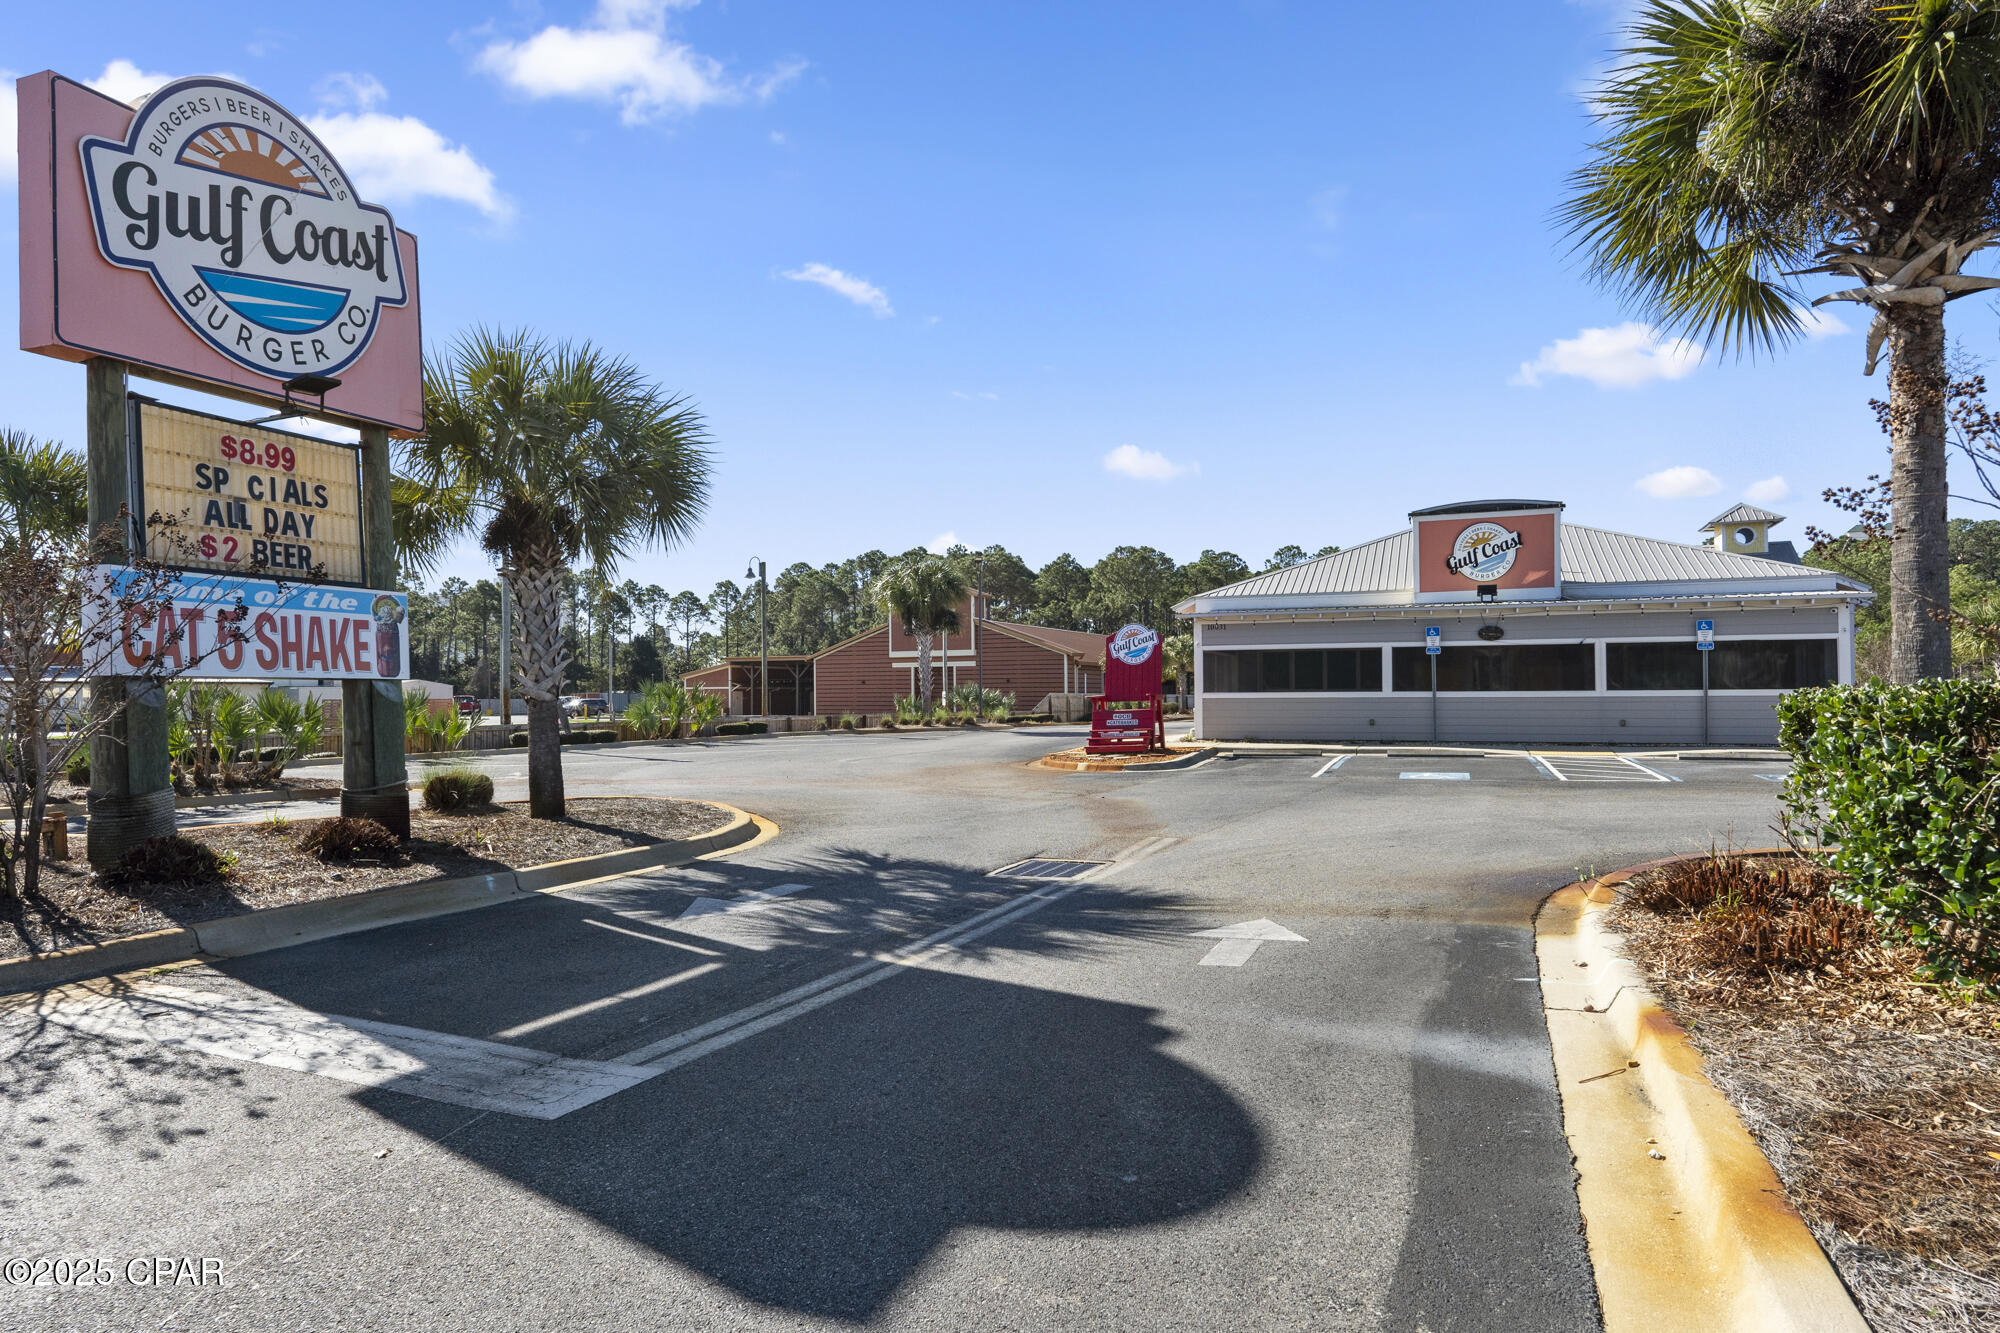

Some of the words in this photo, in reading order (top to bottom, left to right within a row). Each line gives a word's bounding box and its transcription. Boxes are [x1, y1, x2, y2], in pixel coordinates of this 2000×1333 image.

[148, 97, 211, 157] BURGERS
[226, 98, 272, 127] BEER
[289, 131, 347, 201] SHAKES
[112, 161, 253, 268] Gulf
[260, 194, 388, 282] Coast
[183, 283, 330, 365] BURGER
[220, 435, 296, 472] $8.99
[203, 499, 253, 531] ALL
[263, 507, 315, 539] DAY
[252, 539, 312, 571] BEER
[1446, 547, 1479, 575] Gulf
[1482, 532, 1523, 558] Coast
[1469, 570, 1501, 579] BURGER
[254, 587, 298, 606] of
[303, 591, 359, 611] the
[121, 604, 204, 669] CAT
[217, 610, 244, 670] 5
[254, 611, 372, 672] SHAKE
[1113, 639, 1131, 655] Gulf
[1132, 632, 1155, 647] Coast
